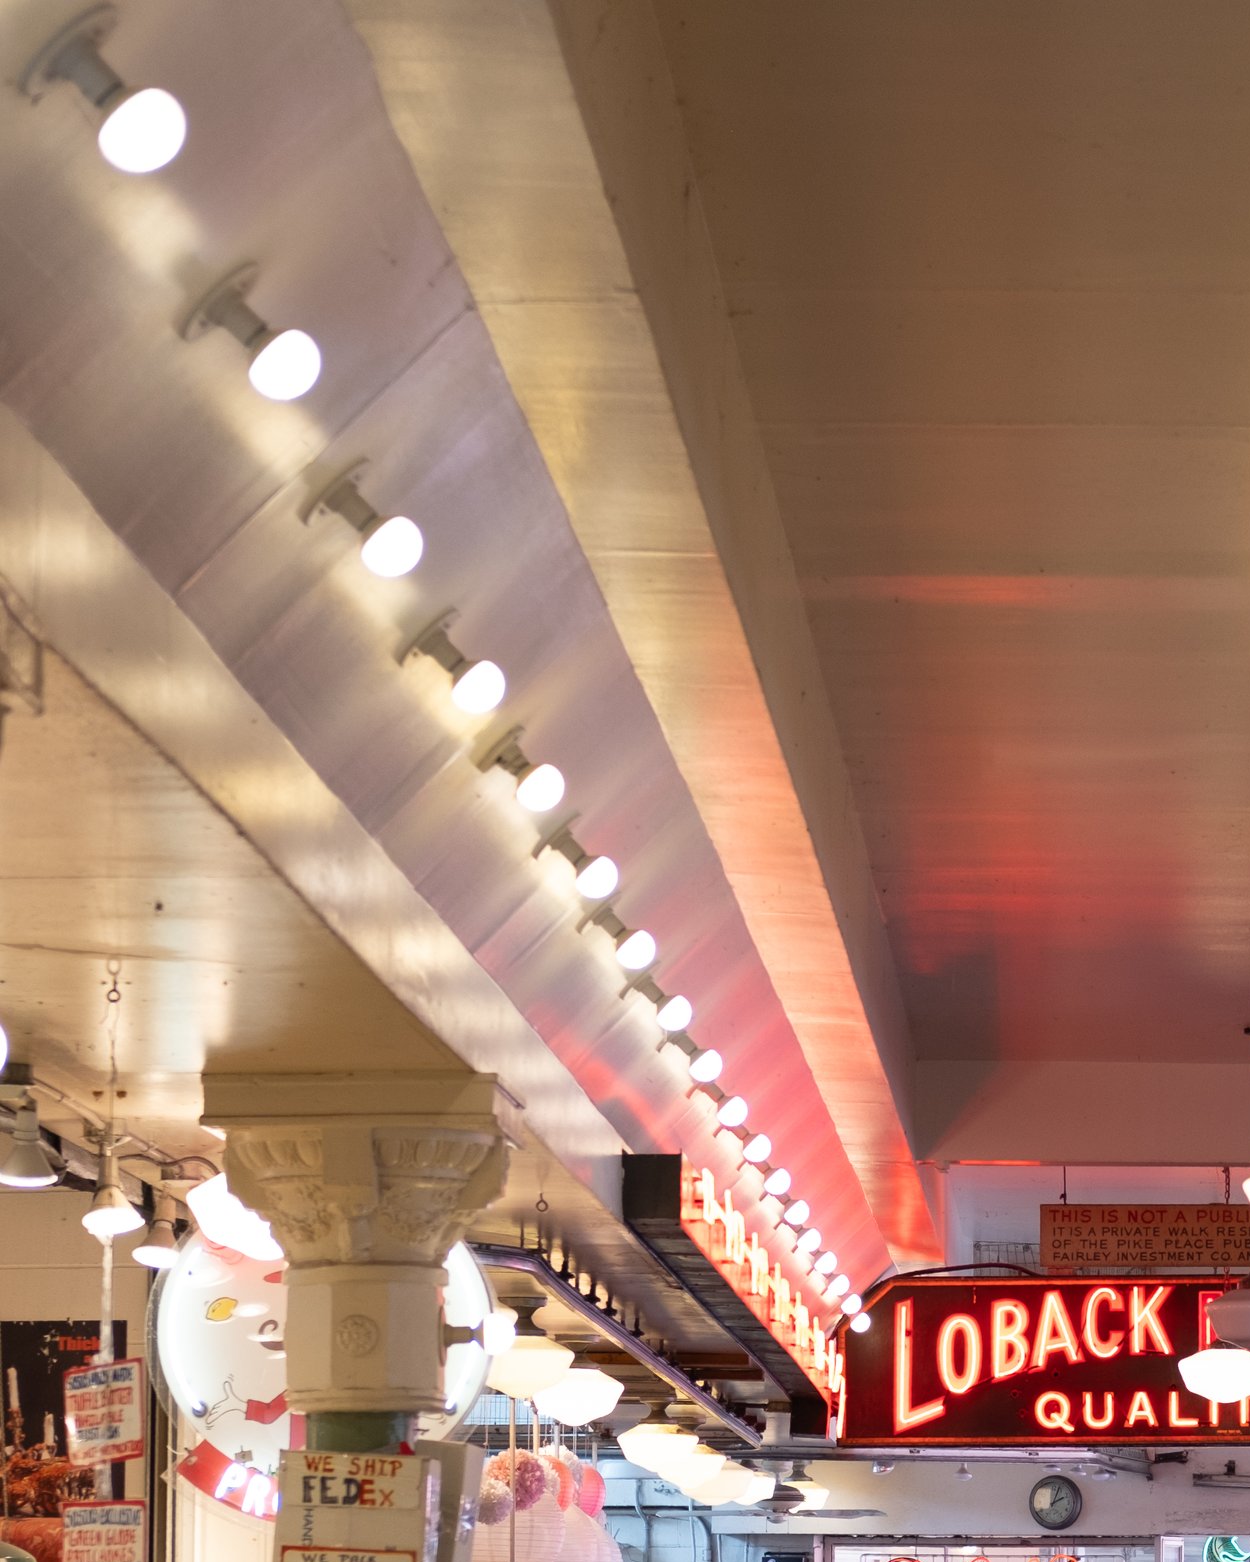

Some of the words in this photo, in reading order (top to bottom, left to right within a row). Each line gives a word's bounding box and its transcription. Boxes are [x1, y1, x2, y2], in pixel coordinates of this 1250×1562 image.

[1049, 1209, 1092, 1224] THIS
[1101, 1209, 1119, 1224] IS
[1127, 1209, 1168, 1225] NOT
[1174, 1210, 1187, 1224] A
[1052, 1227, 1064, 1237] IT
[1070, 1227, 1082, 1237] IS
[1087, 1227, 1097, 1237] A
[1102, 1226, 1160, 1237] PRIVATE
[1168, 1226, 1208, 1237] WALK
[1052, 1238, 1072, 1249] OF
[1081, 1238, 1107, 1249] THE
[1116, 1238, 1153, 1249] PIKE
[1164, 1238, 1214, 1249] PLACE
[1052, 1251, 1111, 1262] FAIRLEY
[1116, 1251, 1203, 1262] INVESTMENT
[893, 1285, 1176, 1435] LOBACK
[304, 1455, 334, 1473] WE
[348, 1457, 403, 1477] SHIP
